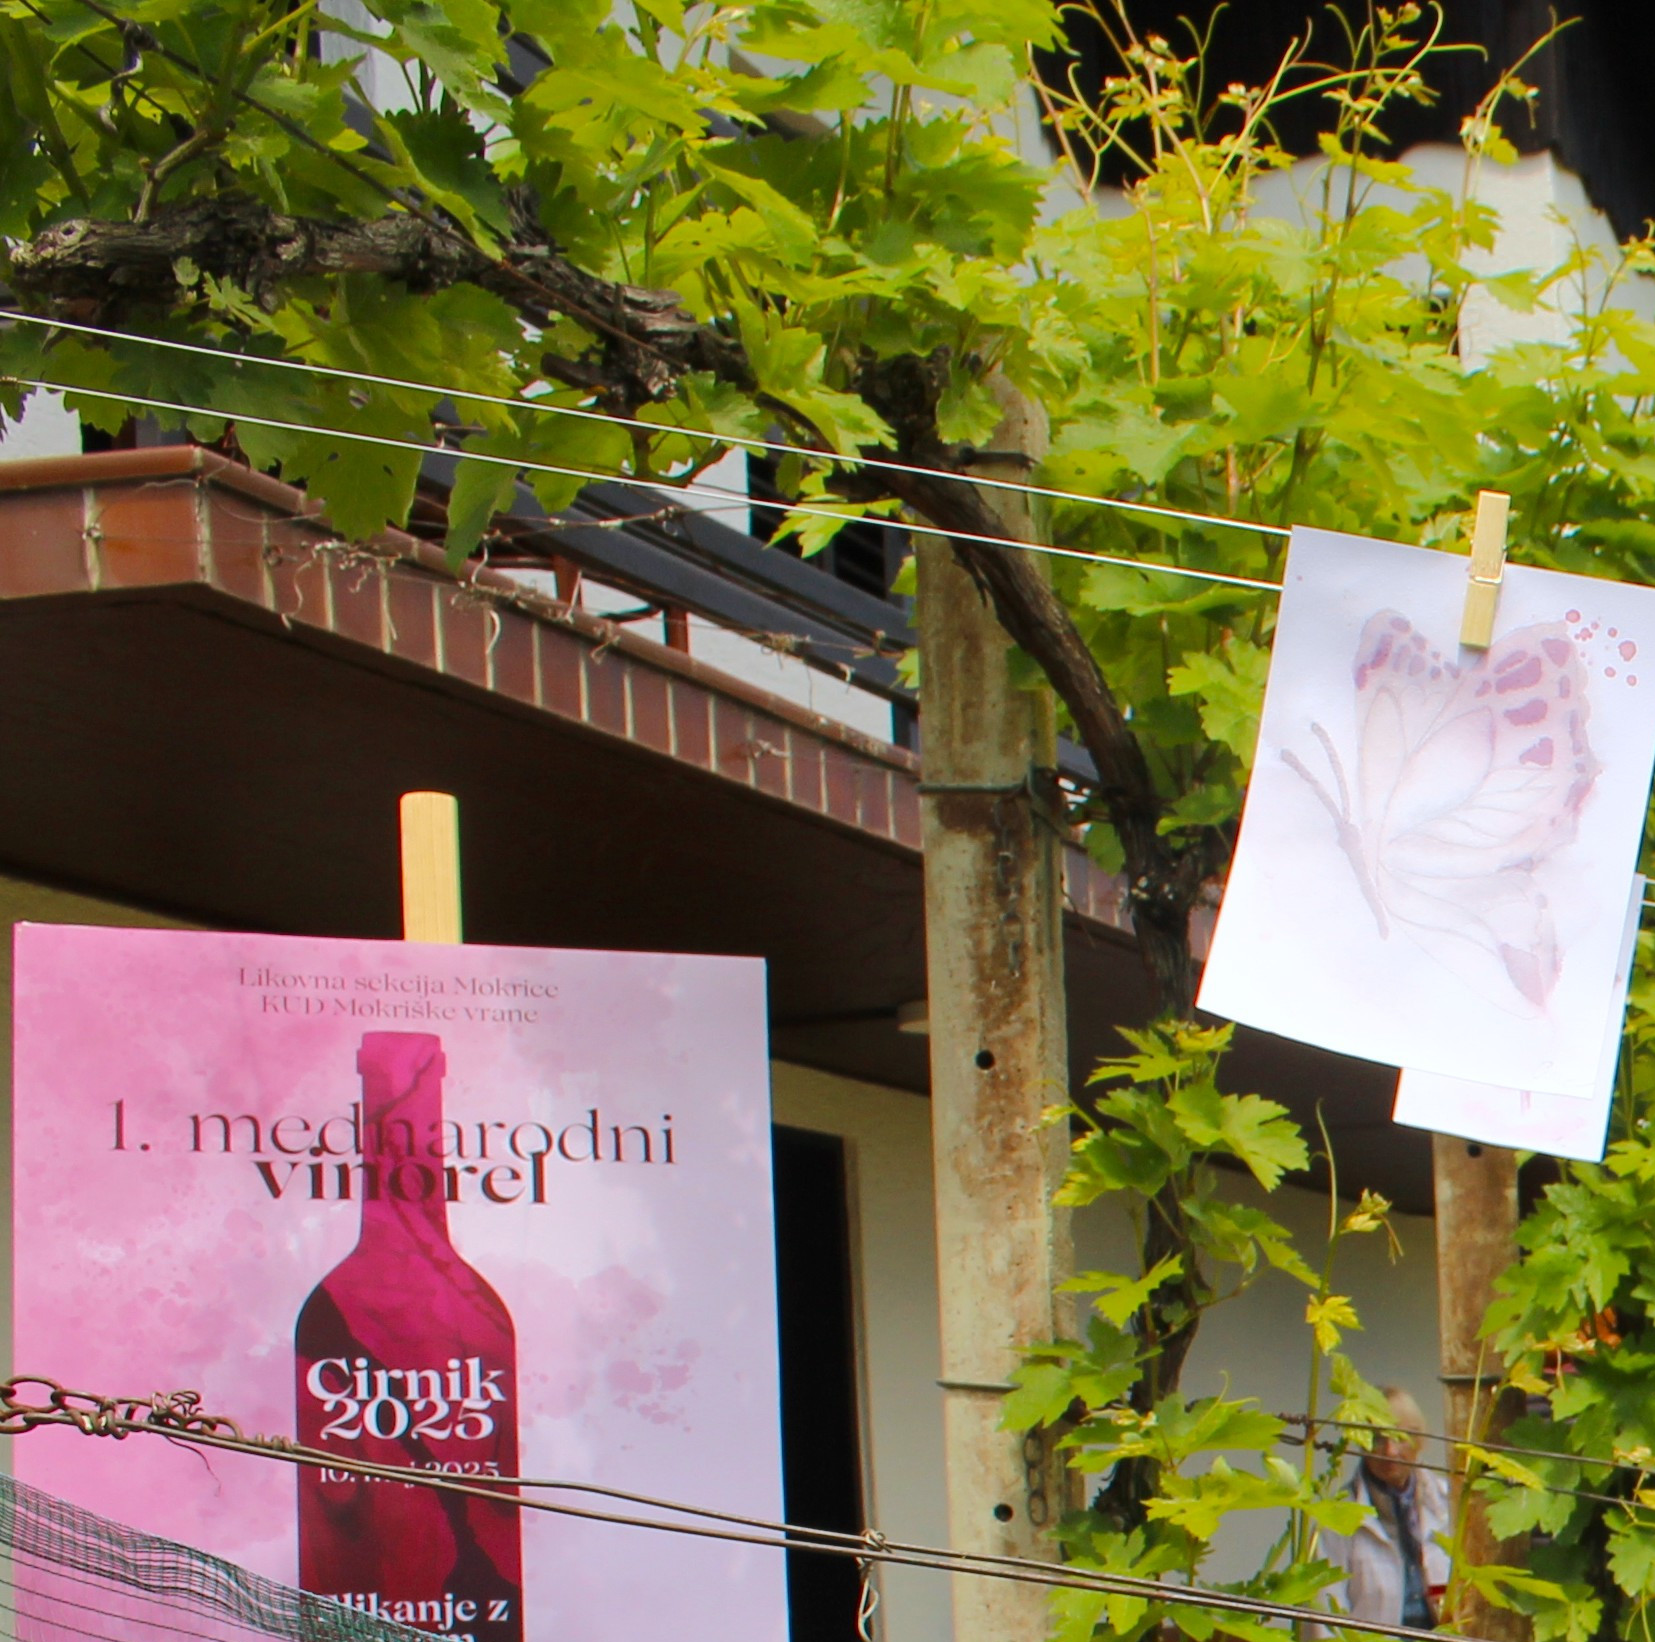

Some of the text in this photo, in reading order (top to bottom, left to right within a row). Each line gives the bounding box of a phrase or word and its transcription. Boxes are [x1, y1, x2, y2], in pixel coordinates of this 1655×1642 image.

[239, 967, 559, 998] Likovna sekcija Mokrice
[261, 995, 539, 1023] KUD Mokriške vrane
[108, 1098, 679, 1164] 1. mednarodni
[250, 1146, 550, 1204] vinorel
[306, 1356, 507, 1402] Cirnik
[320, 1397, 495, 1441] 2025
[320, 1592, 510, 1631] likanje z
